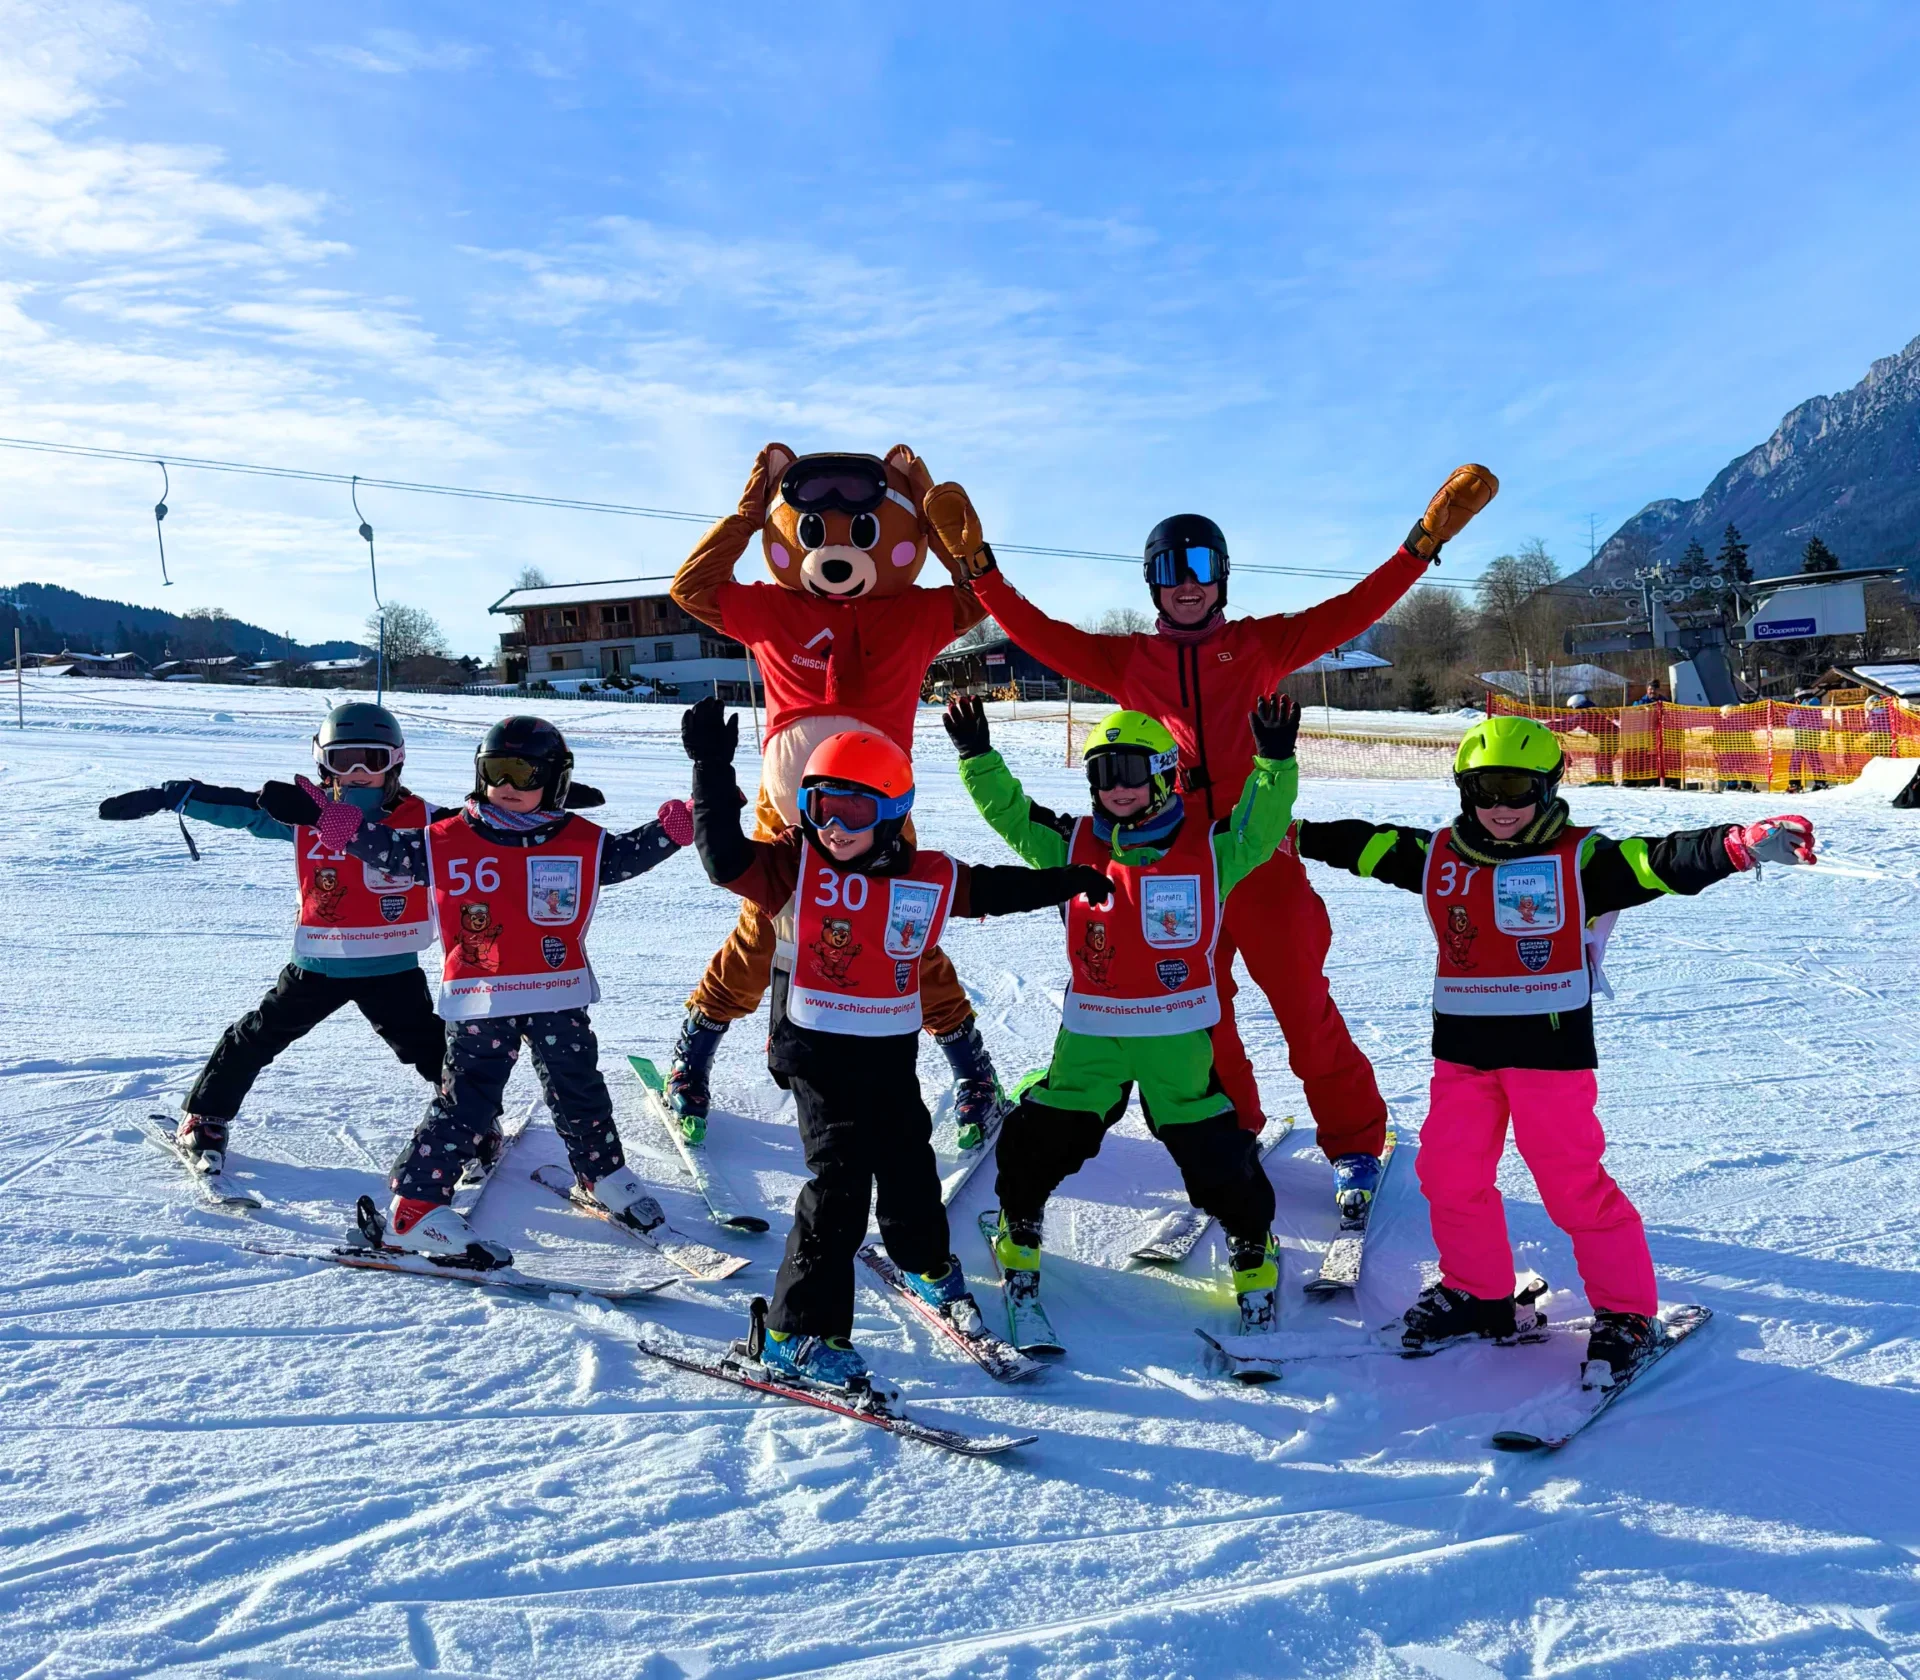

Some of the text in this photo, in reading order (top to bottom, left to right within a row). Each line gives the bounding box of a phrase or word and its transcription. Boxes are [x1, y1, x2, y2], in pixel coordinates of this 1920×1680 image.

[447, 856, 501, 897] 56
[541, 875, 564, 883] ANNA
[1436, 861, 1480, 897] 37
[1509, 878, 1537, 887] TINA
[814, 868, 869, 911] 30
[901, 903, 922, 914] HUGO
[306, 928, 419, 942] www.schischule-going.at
[451, 976, 581, 996] www.schischule-going.at
[1443, 979, 1572, 994] www.schischule-going.at
[805, 996, 916, 1016] www.schischule-going.at
[1078, 994, 1207, 1015] www.schischule-going.at
